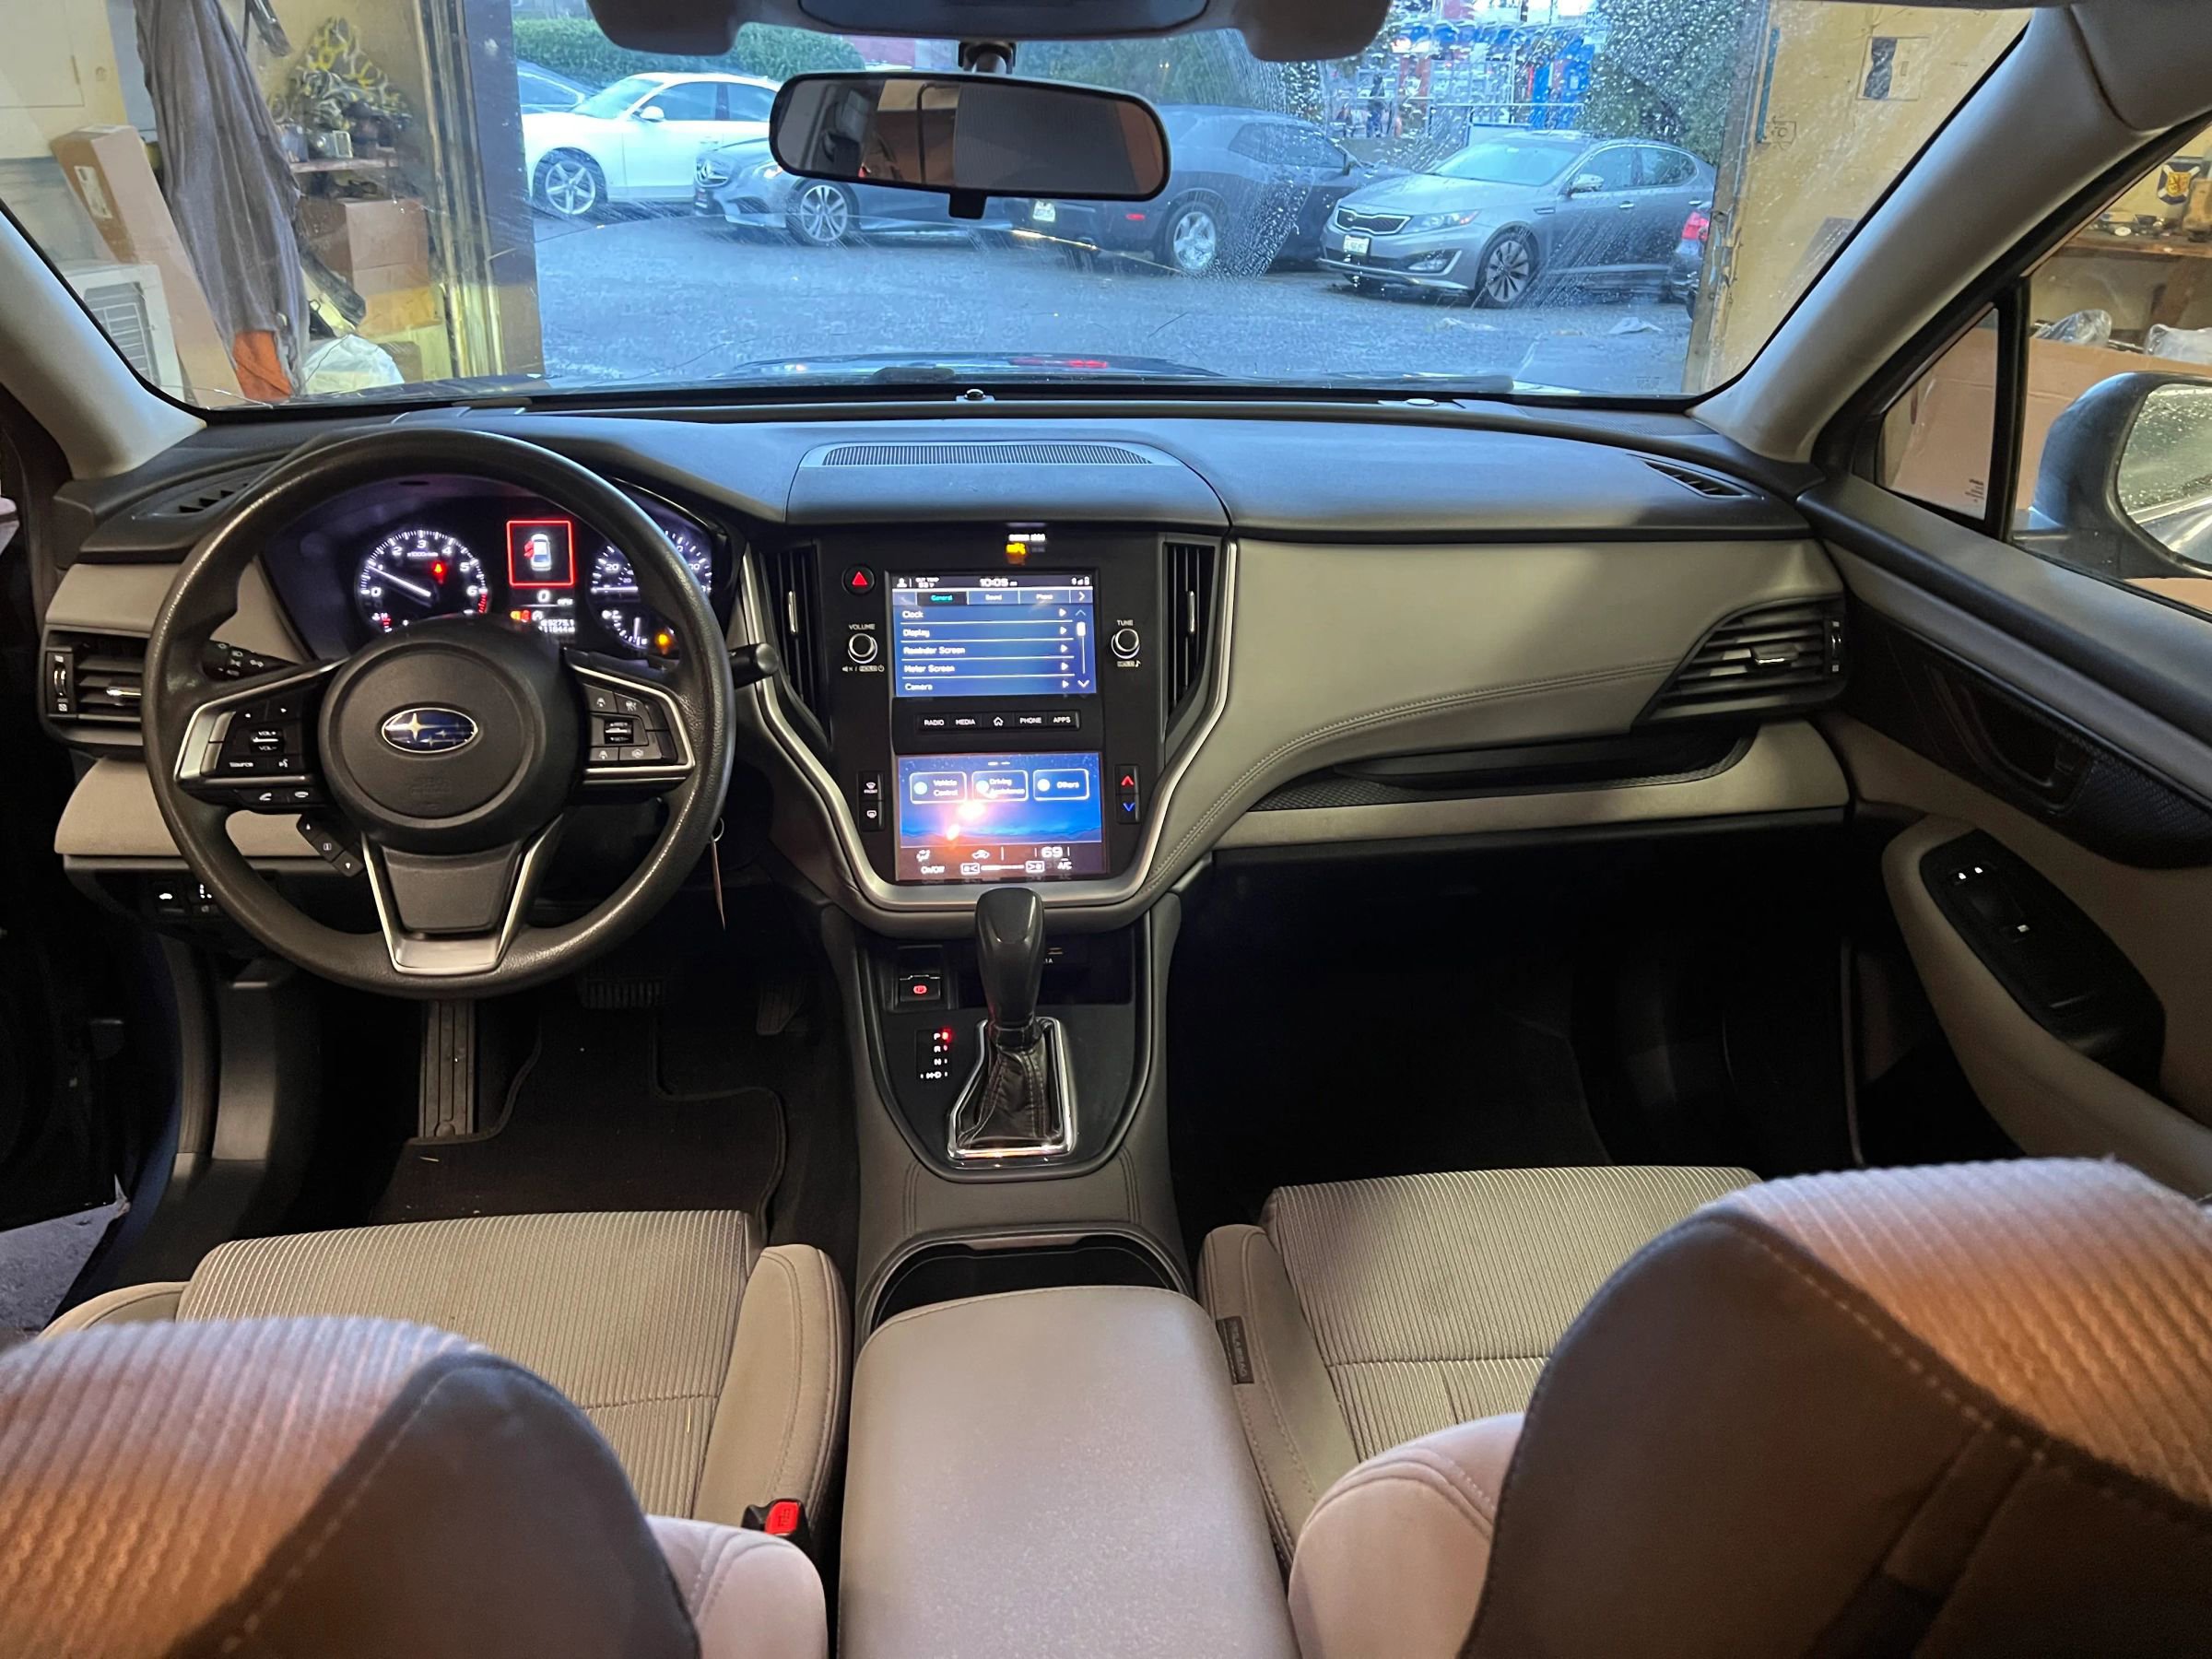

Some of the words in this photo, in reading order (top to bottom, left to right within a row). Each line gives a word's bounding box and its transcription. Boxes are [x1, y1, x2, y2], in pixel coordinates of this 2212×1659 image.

[417, 539, 427, 549] 3
[392, 546, 403, 556] 2
[442, 546, 453, 556] 4
[459, 561, 470, 572] 5
[605, 563, 619, 572] 20
[371, 586, 382, 597] 0
[467, 584, 477, 597] 6
[537, 589, 550, 603] 0
[901, 609, 924, 618] Clock
[1116, 618, 1134, 627] TUNE
[902, 629, 930, 638] Display
[902, 646, 937, 655] Reminder
[938, 645, 966, 654] Screen
[903, 665, 927, 674] Meter
[928, 664, 956, 673] Screen
[904, 682, 934, 691] Camera
[955, 718, 976, 726] MEDIA
[1019, 716, 1042, 724] PHONE
[1053, 716, 1072, 724] APPS
[989, 778, 1012, 786] Driving
[933, 789, 959, 797] Control
[1041, 846, 1063, 858] 69
[934, 1032, 941, 1041] P
